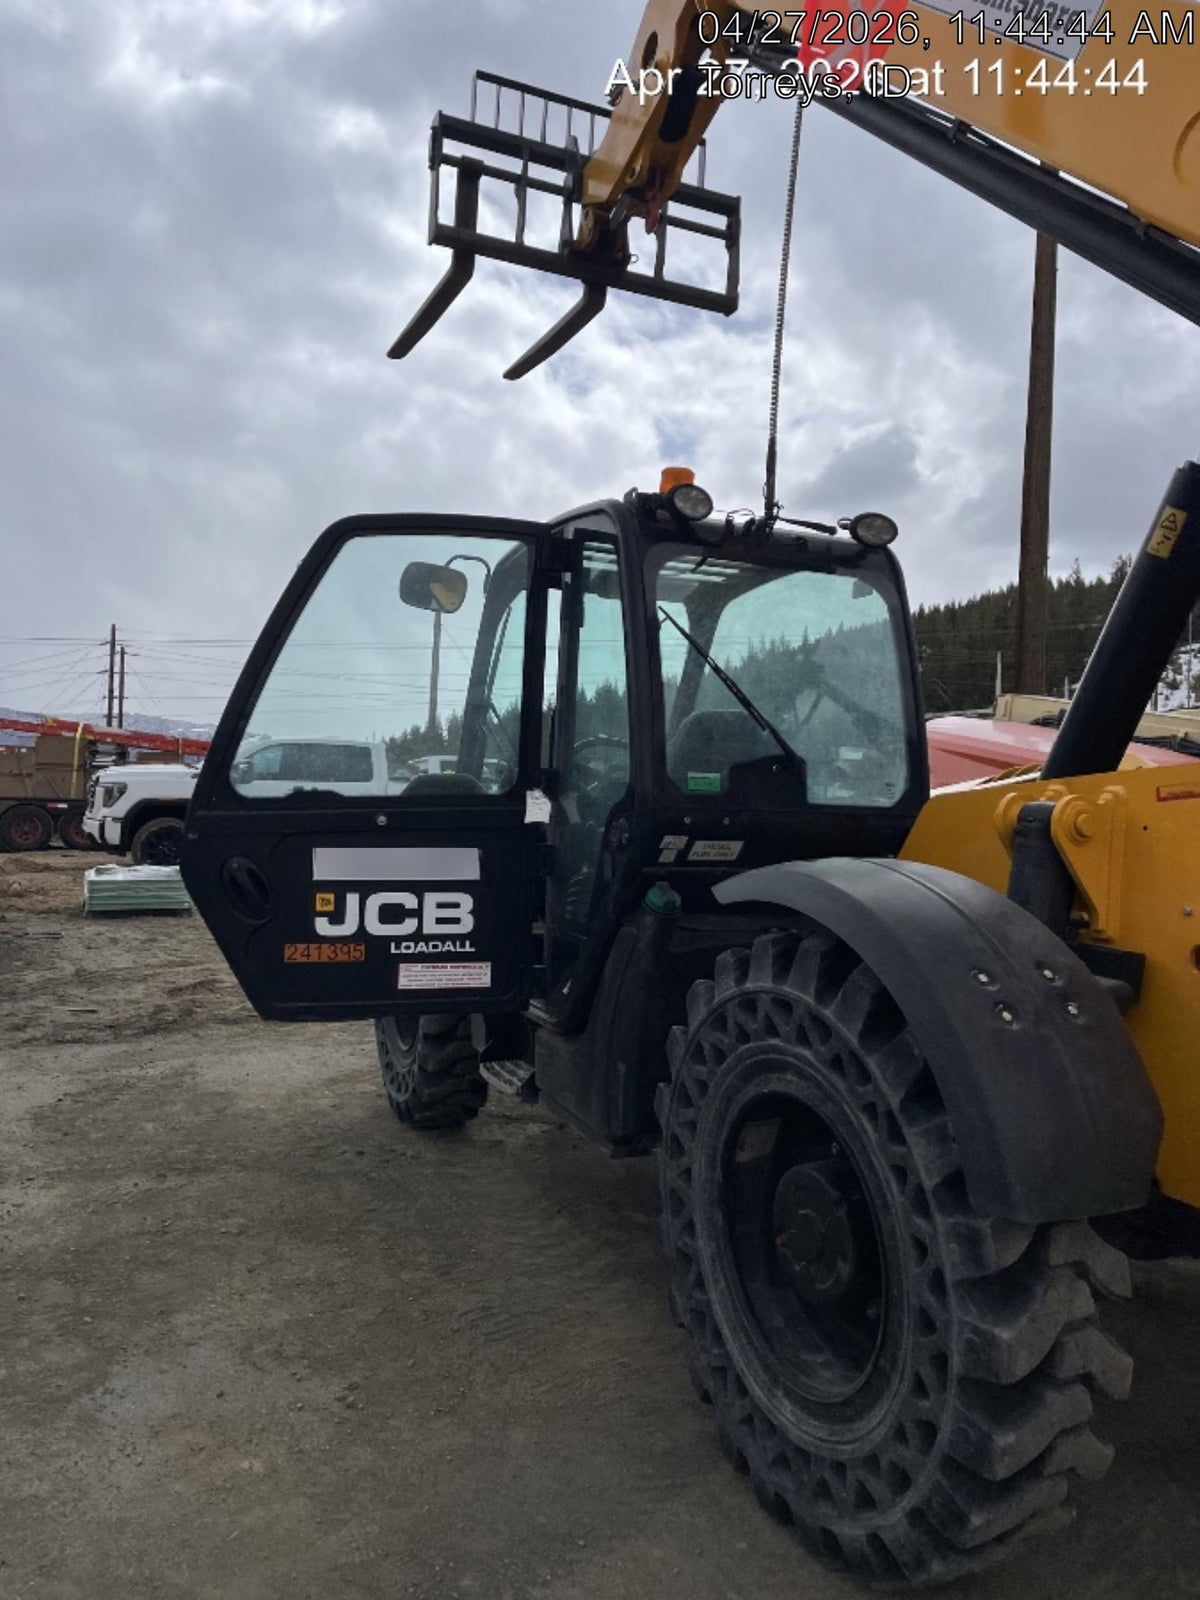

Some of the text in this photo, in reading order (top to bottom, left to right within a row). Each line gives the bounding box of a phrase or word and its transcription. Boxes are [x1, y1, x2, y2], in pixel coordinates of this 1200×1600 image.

[314, 892, 474, 937] JCB
[286, 943, 364, 961] 241395
[390, 940, 476, 954] LOADALL
